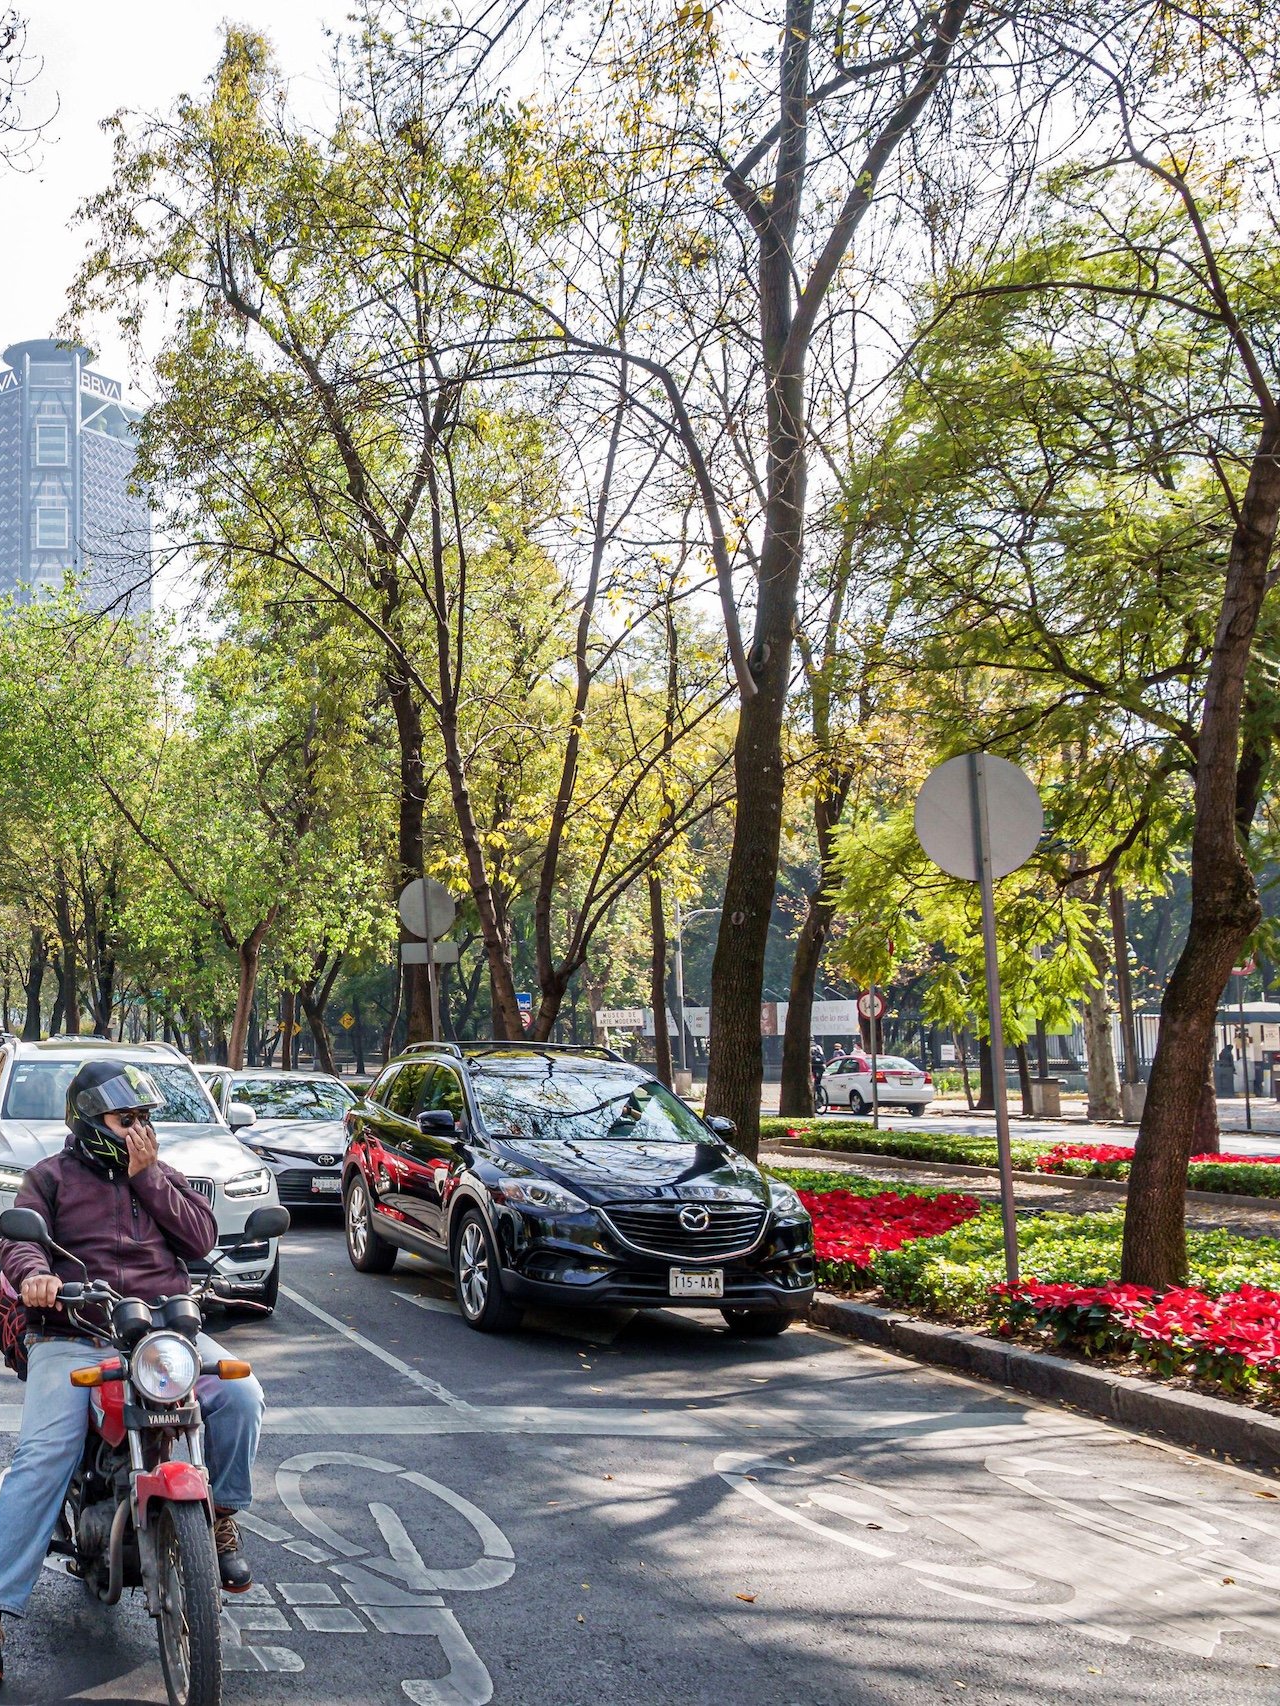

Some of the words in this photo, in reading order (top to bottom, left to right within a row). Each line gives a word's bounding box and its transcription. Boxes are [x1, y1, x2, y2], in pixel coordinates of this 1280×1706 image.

[81, 372, 120, 400] BBVA
[674, 1276, 720, 1289] T15-AAA
[148, 1414, 181, 1424] YAMAHA
